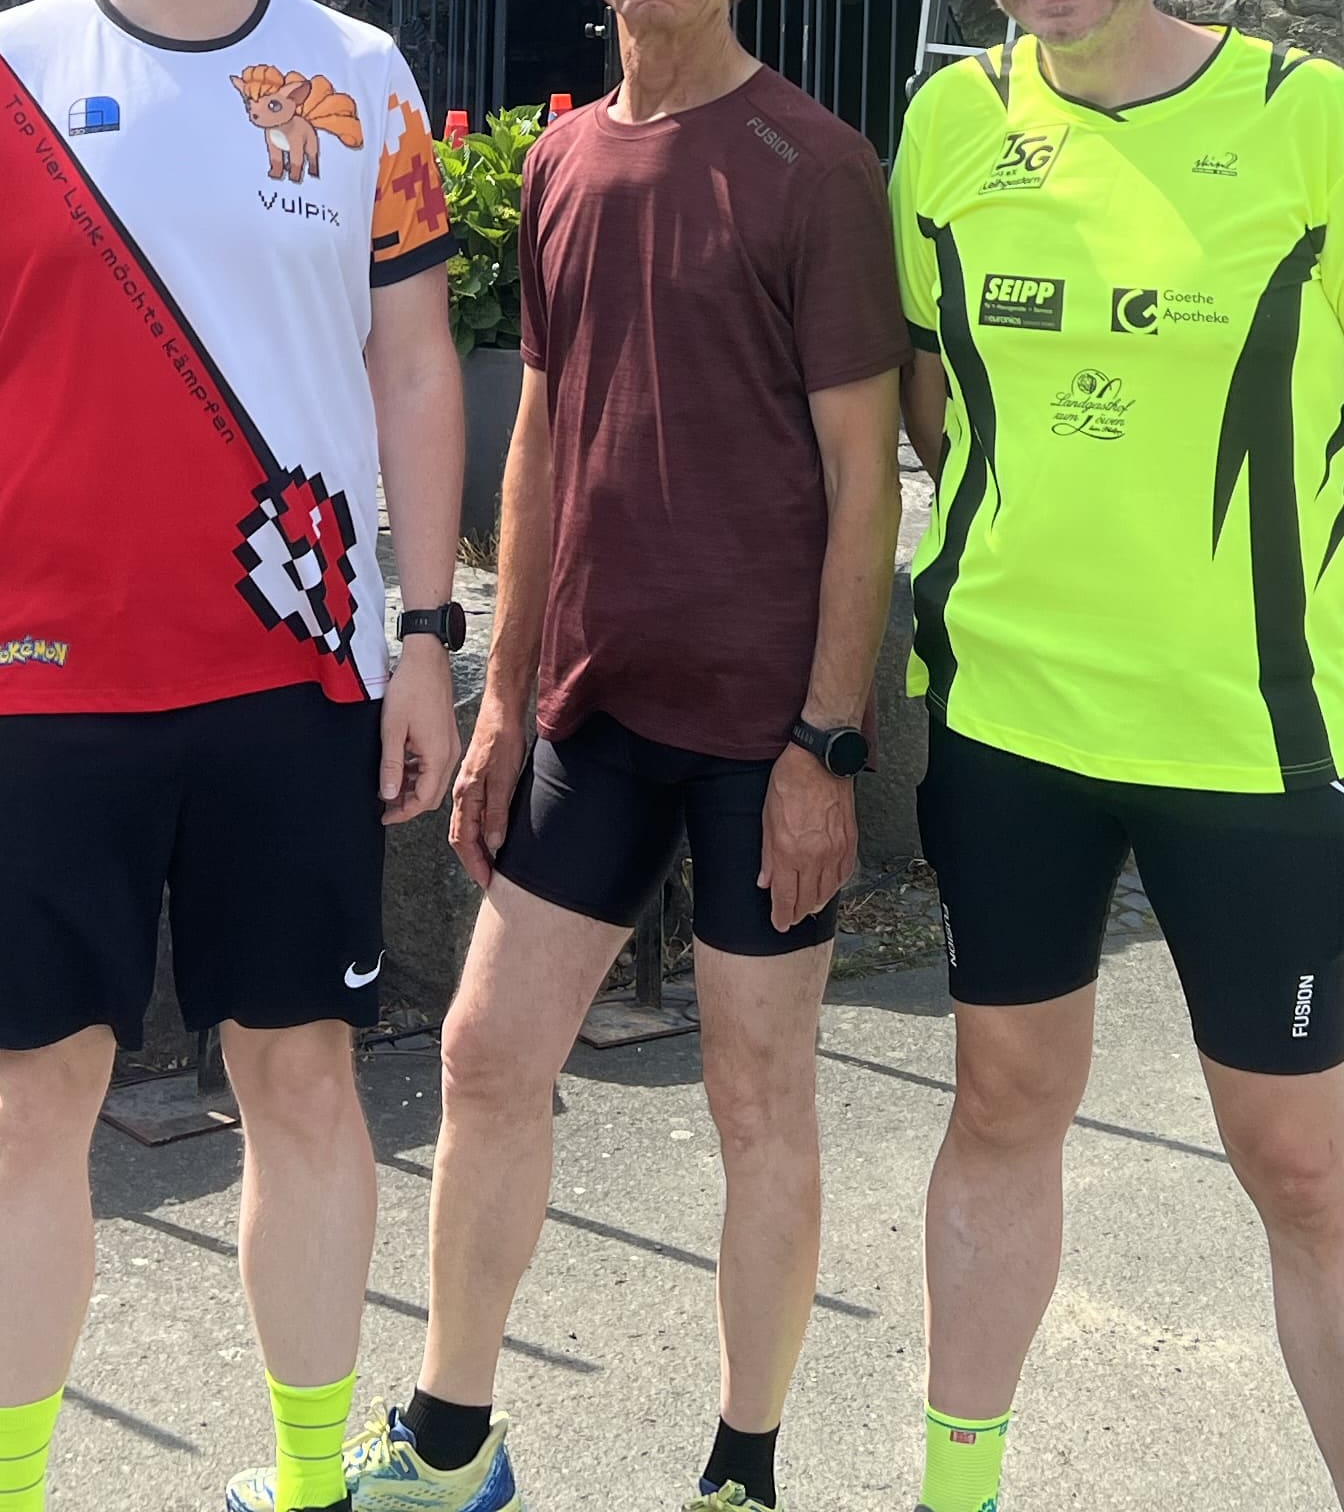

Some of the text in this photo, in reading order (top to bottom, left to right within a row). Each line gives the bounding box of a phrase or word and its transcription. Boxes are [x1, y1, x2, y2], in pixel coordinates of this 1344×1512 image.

[746, 116, 799, 164] FUSION
[996, 133, 1054, 172] TSG
[258, 189, 341, 227] Vulpix
[35, 137, 68, 184] Vier
[64, 188, 105, 246] Lynk
[101, 247, 164, 337] möchte
[162, 337, 235, 444] kämpfen
[985, 277, 1056, 305] SEIPP
[1163, 289, 1214, 304] Goethe
[1163, 308, 1230, 324] Apotheke
[1292, 974, 1315, 1038] FUSION
